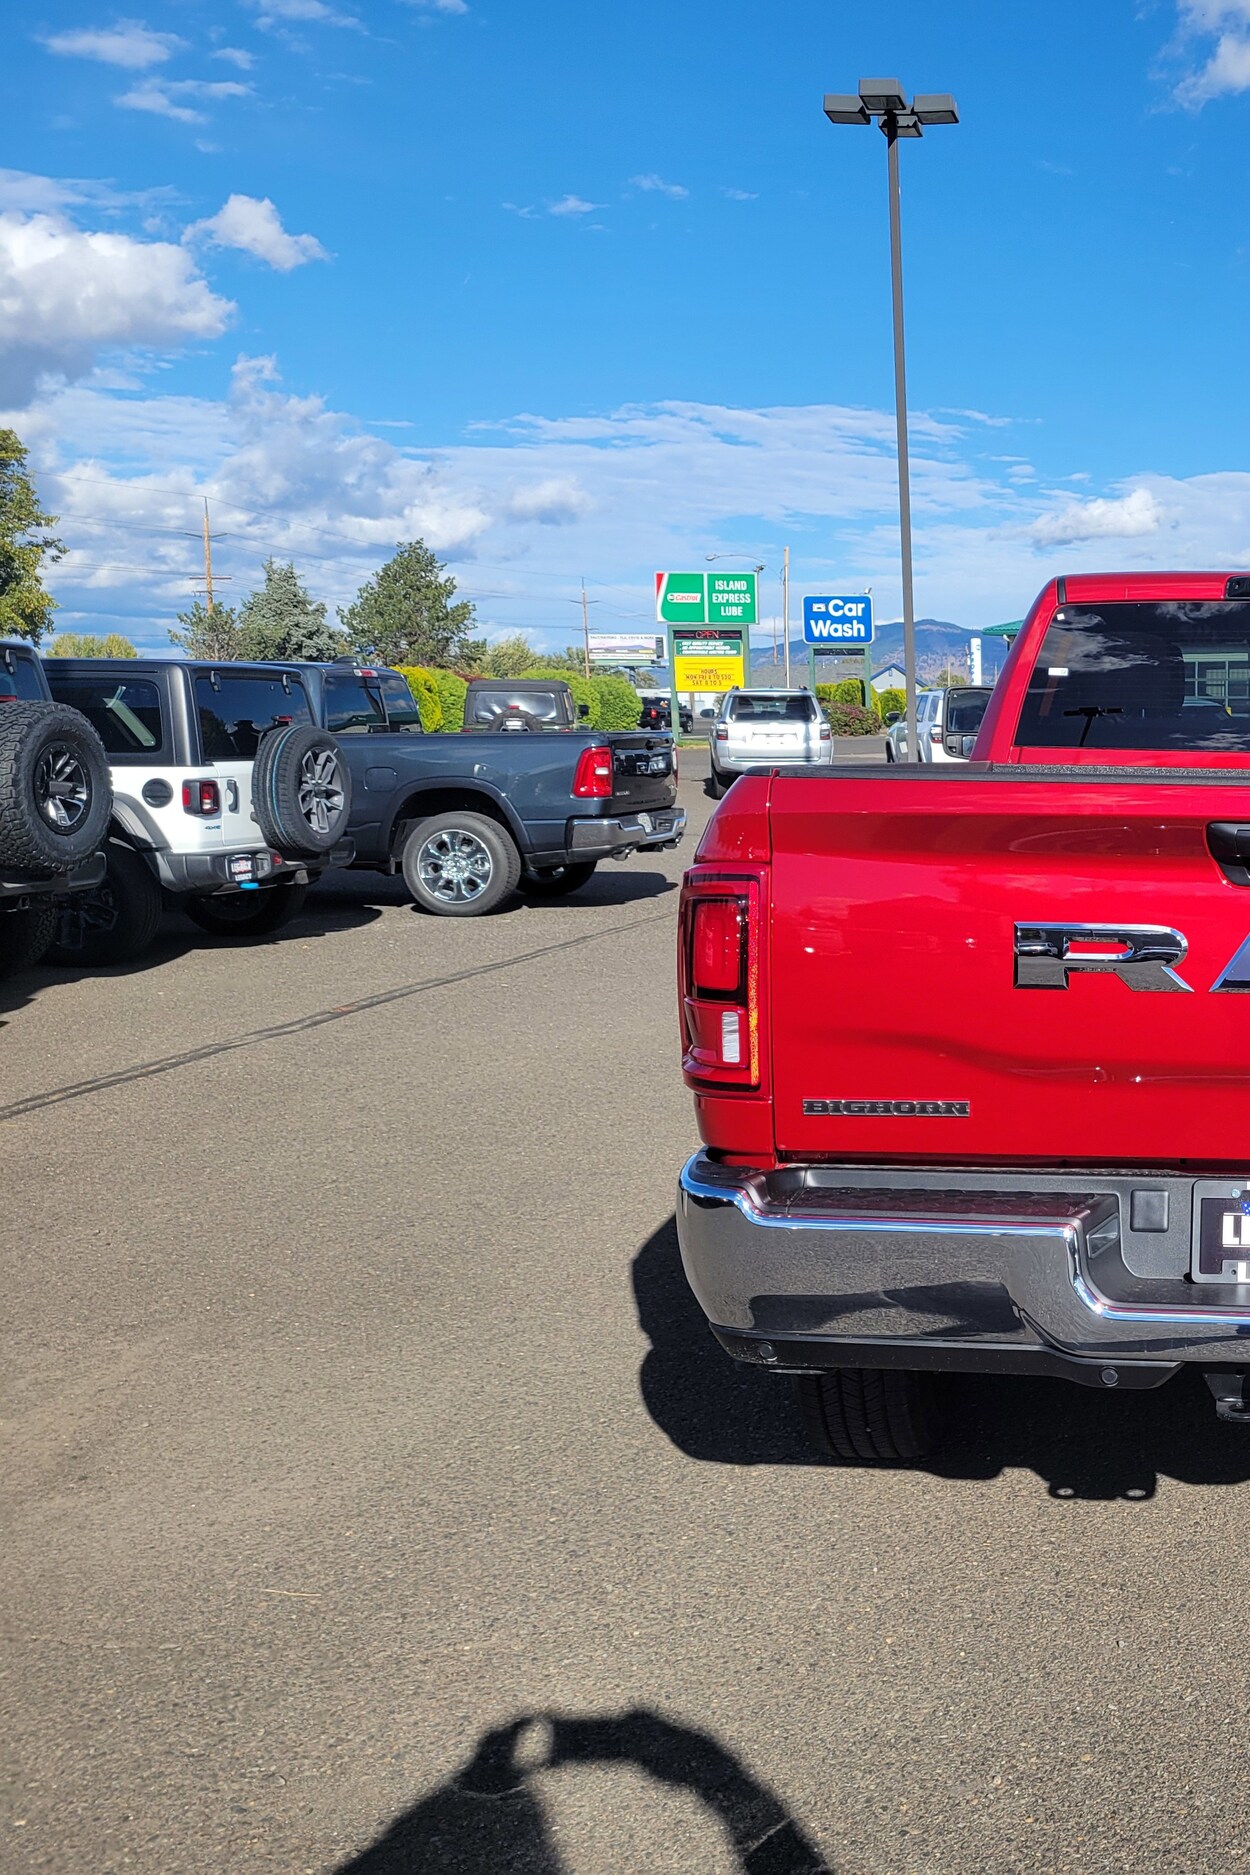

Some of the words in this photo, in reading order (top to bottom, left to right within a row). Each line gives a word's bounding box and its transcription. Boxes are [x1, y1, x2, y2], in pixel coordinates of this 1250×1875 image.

[715, 580, 747, 590] ISLAND
[712, 593, 751, 603] EXPRESS
[721, 606, 743, 616] LUBE
[828, 599, 865, 617] Car
[810, 619, 865, 637] Wash
[695, 630, 720, 639] OPEN
[803, 1099, 970, 1117] BIGHORN
